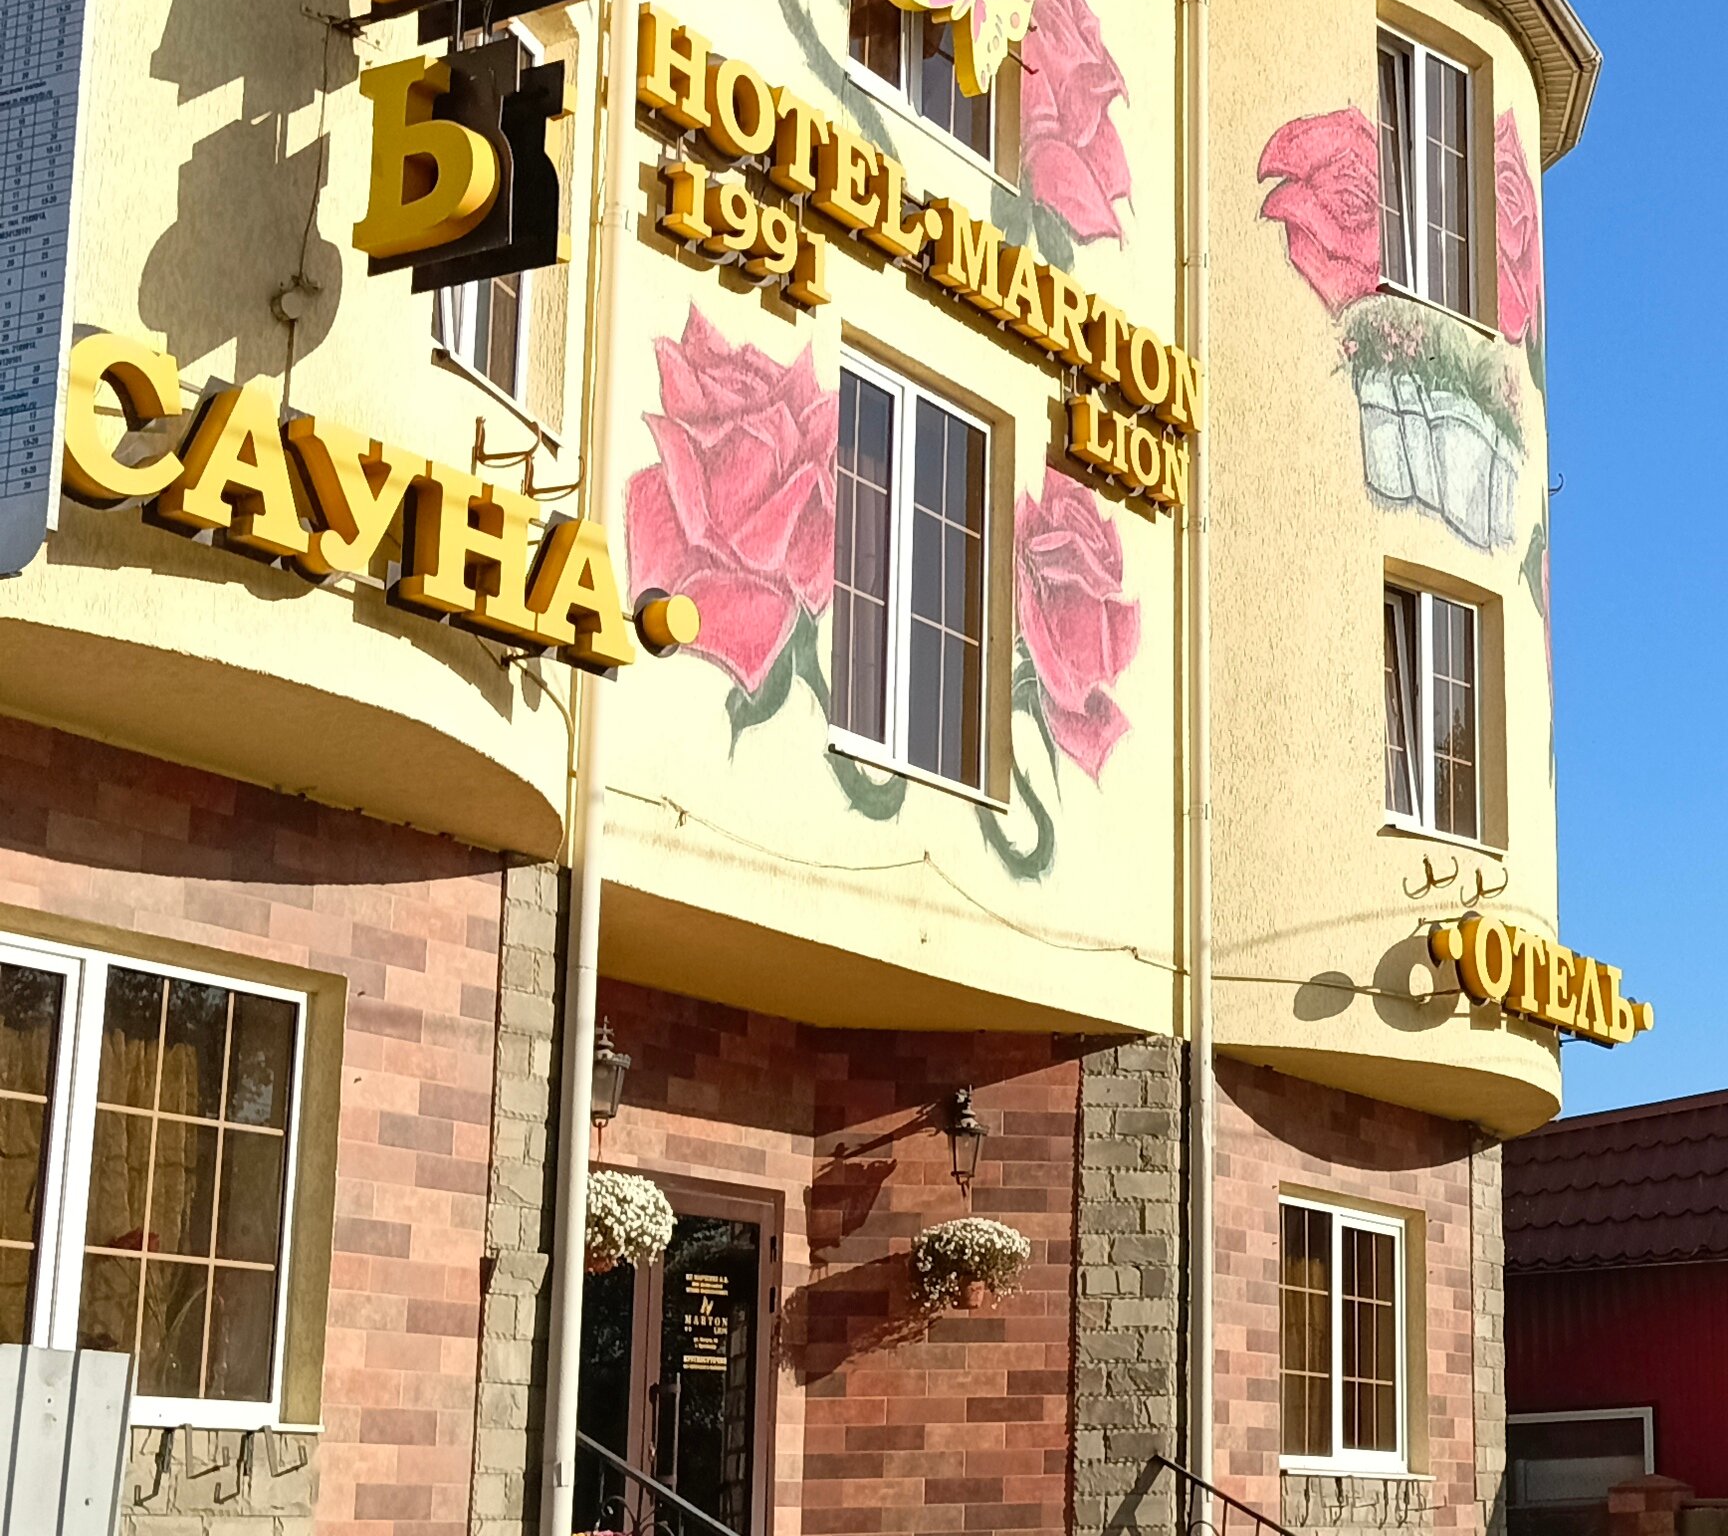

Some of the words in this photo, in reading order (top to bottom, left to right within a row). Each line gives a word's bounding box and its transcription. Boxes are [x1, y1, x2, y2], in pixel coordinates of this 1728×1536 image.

[640, 2, 930, 259] HOTEL
[931, 197, 1204, 434] MARTON
[660, 161, 831, 307] 1991
[65, 332, 638, 671] САУНА
[1070, 391, 1191, 507] LION
[1460, 914, 1636, 1045] ОТЕЛЬ
